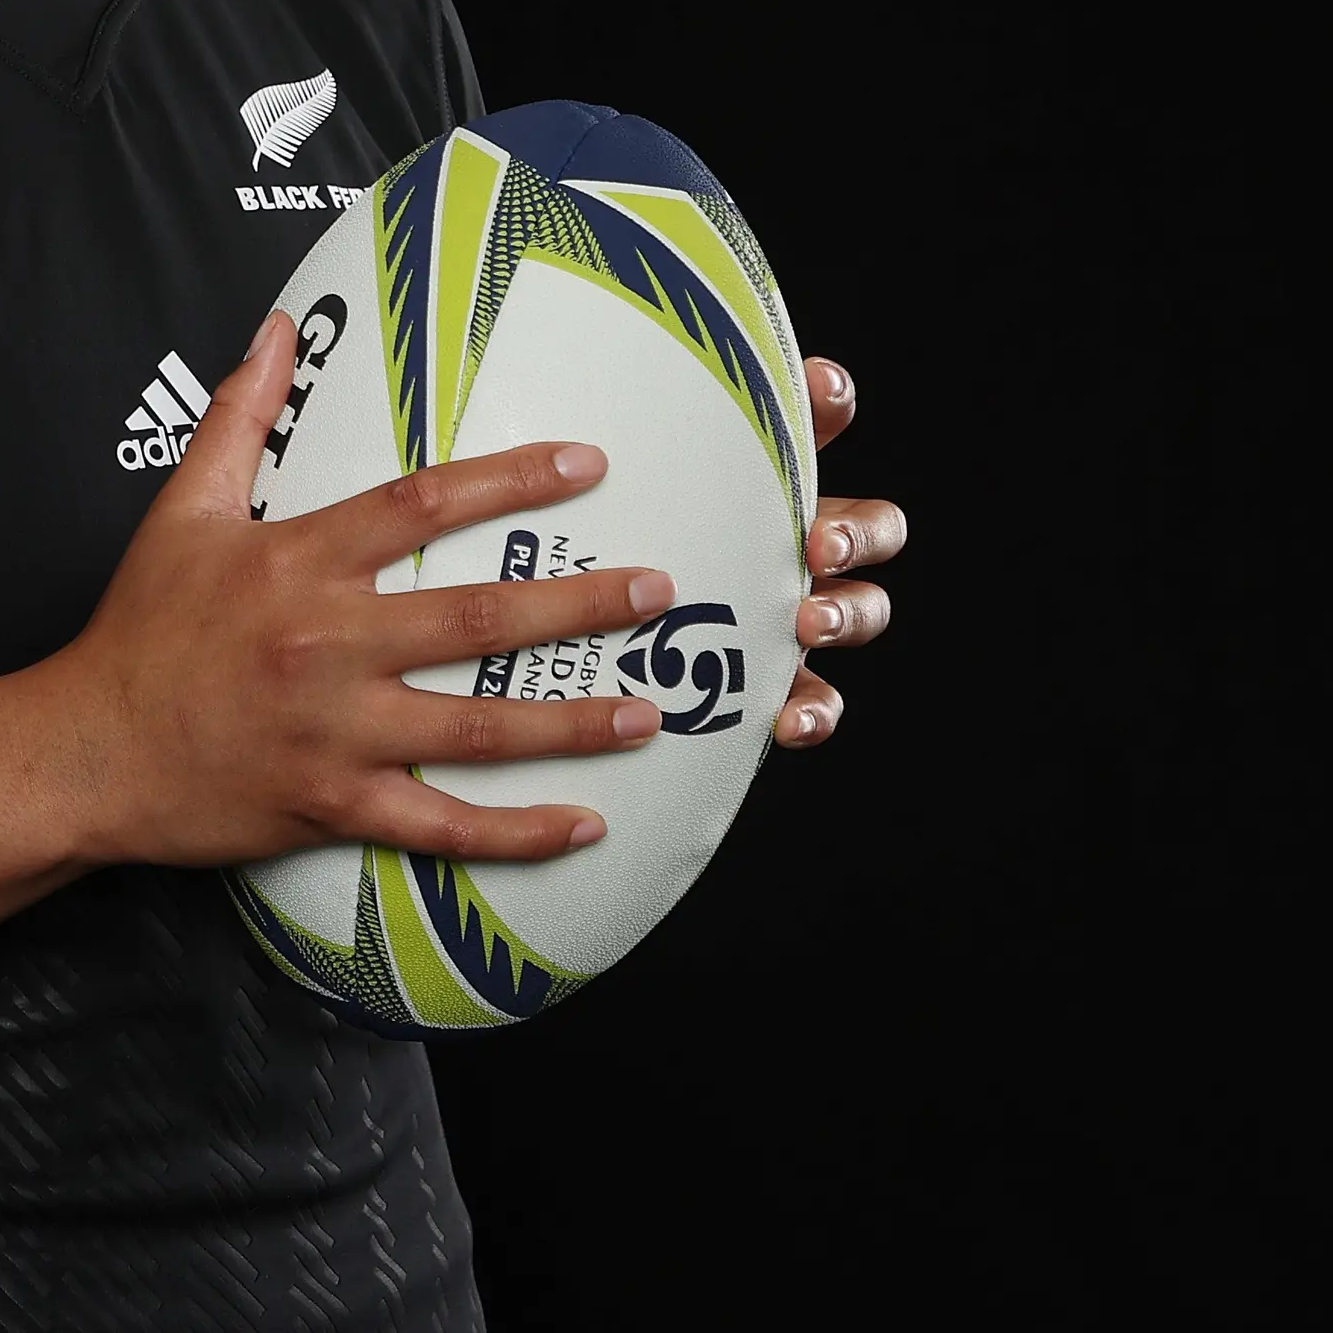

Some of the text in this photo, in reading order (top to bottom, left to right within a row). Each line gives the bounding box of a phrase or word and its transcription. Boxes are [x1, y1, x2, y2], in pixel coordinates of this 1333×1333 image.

[234, 185, 327, 211] BLACK
[117, 422, 198, 471] adi
[577, 633, 605, 698] UGBY
